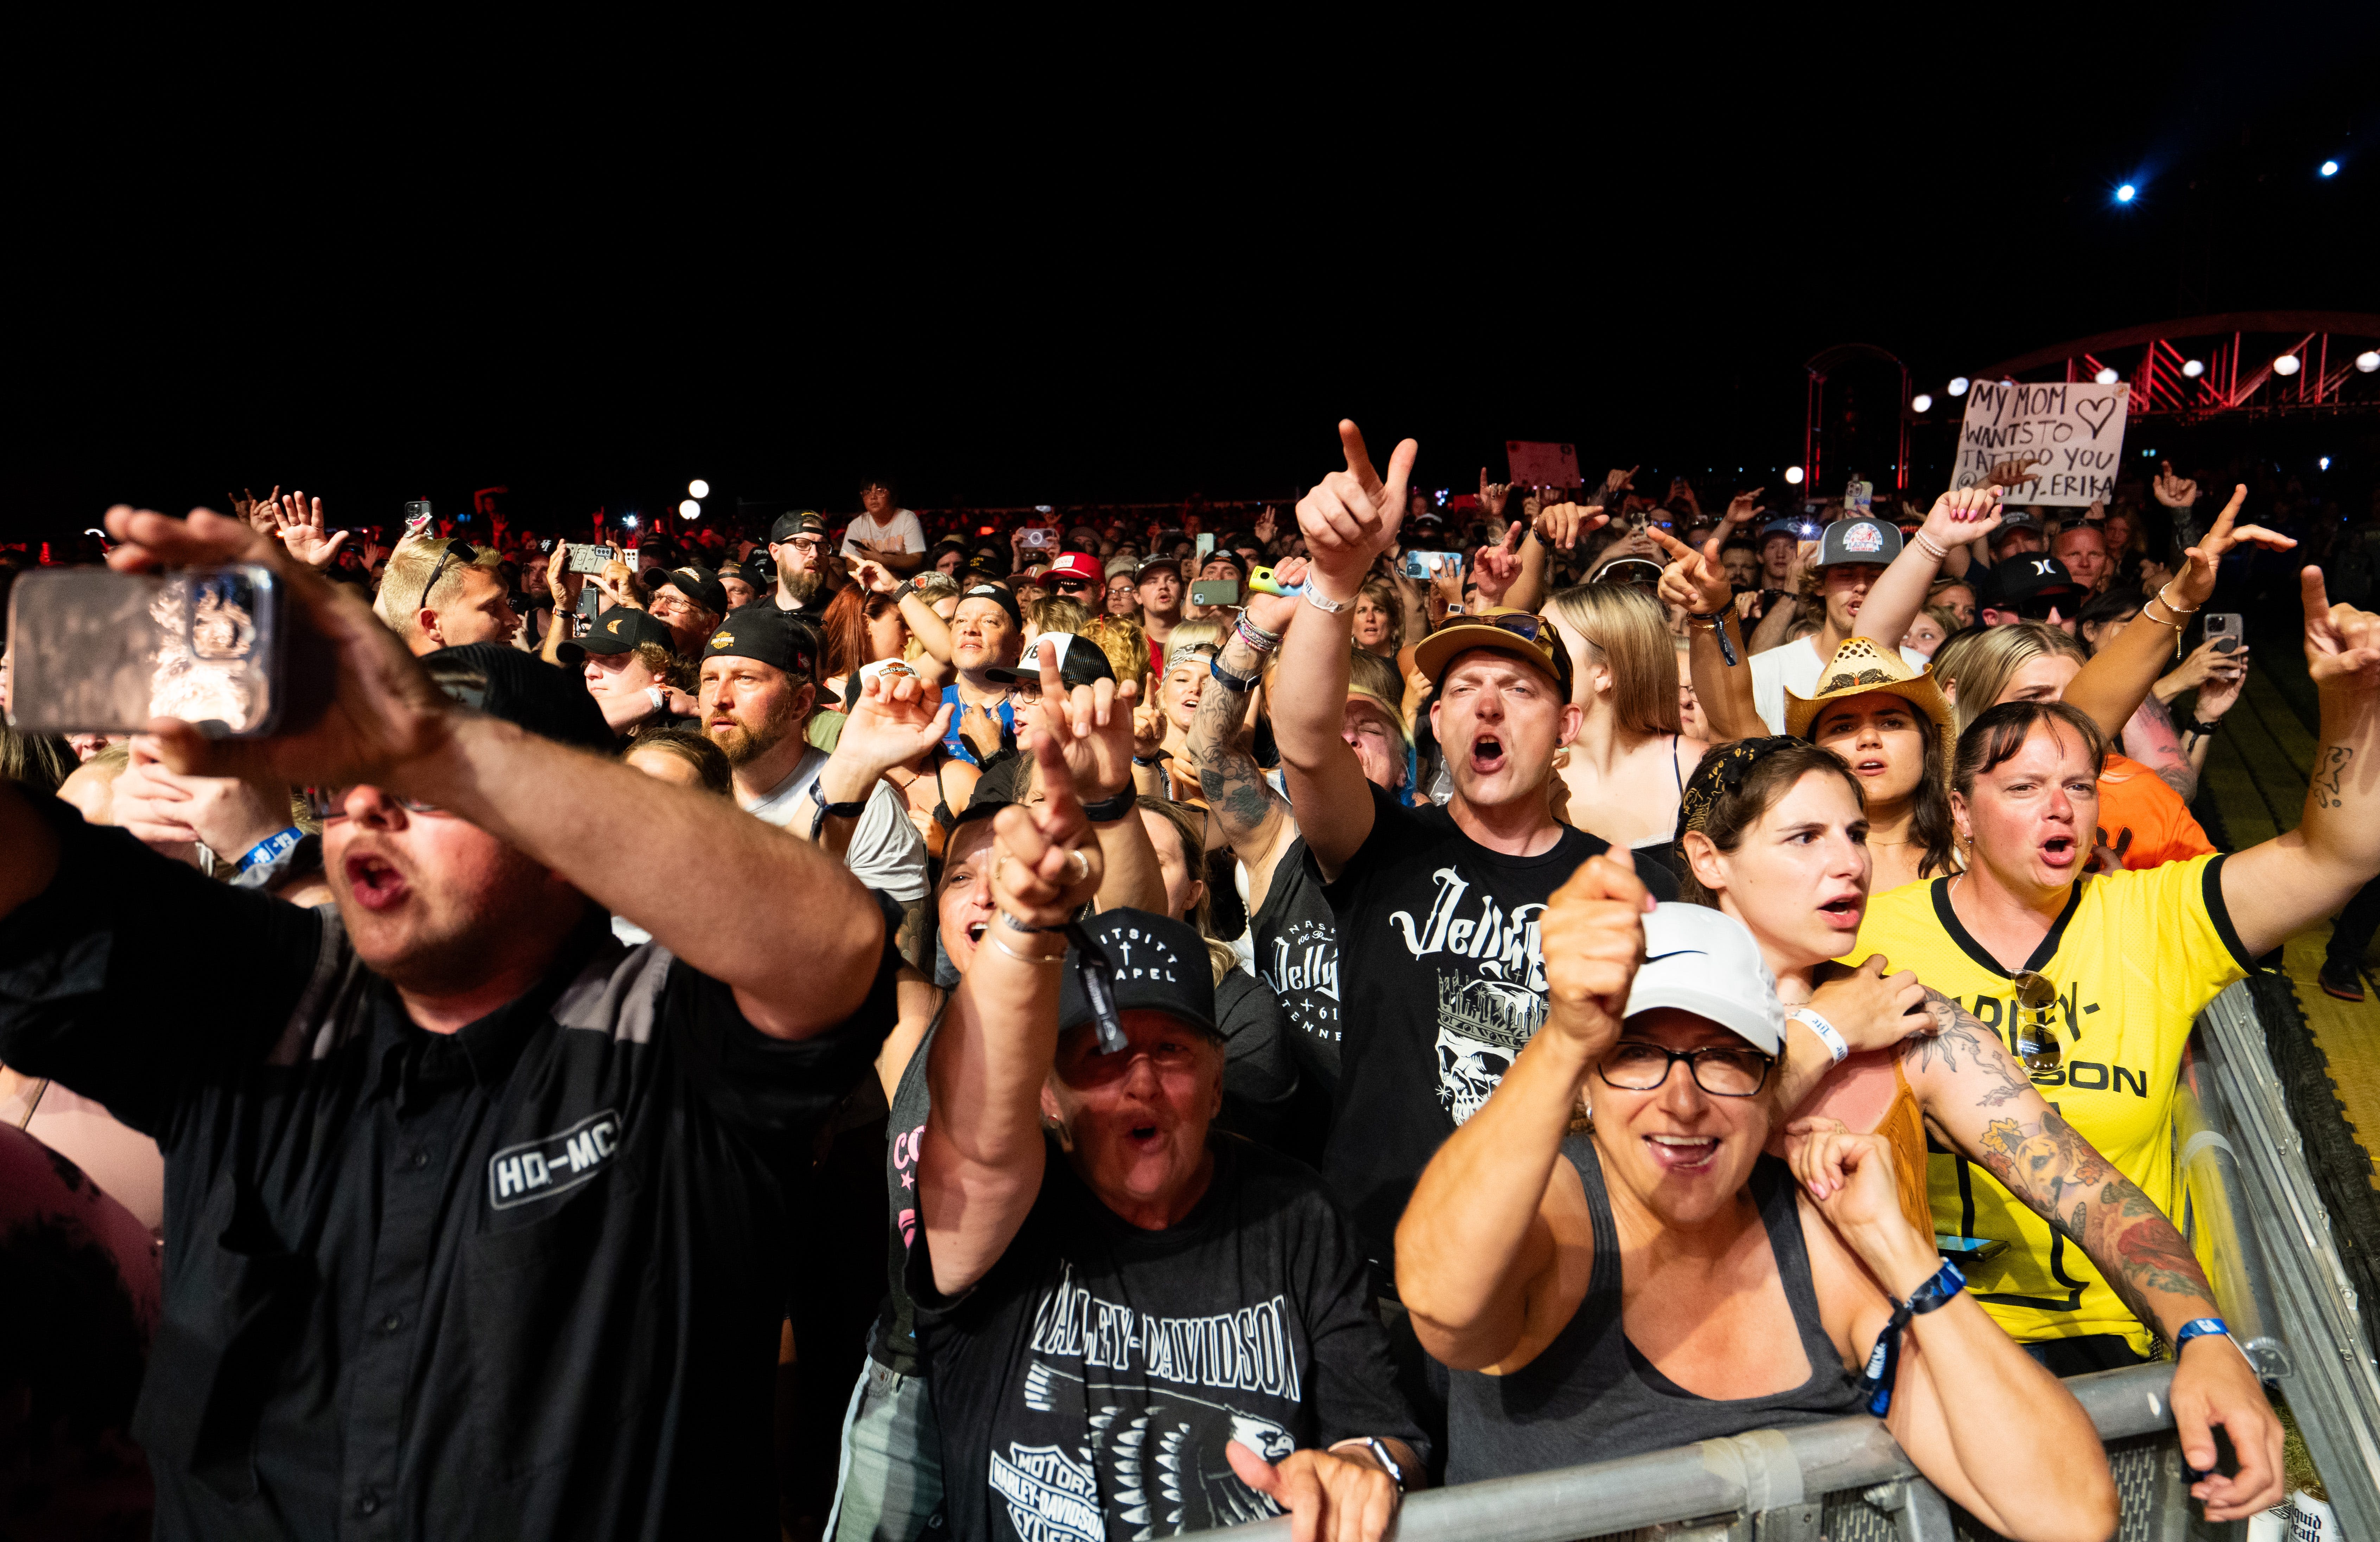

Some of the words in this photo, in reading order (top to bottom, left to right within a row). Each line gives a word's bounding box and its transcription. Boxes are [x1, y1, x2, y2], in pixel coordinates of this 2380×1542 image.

[1970, 384, 2009, 426] MY
[2012, 386, 2068, 418] MOM
[2063, 448, 2115, 471] YOU
[1100, 928, 1178, 963] ITSITT
[1297, 934, 1309, 945] 100
[1115, 968, 1176, 983] APEL
[1261, 936, 1340, 1001] Jelly
[1811, 1018, 1831, 1037] Lite
[2196, 1320, 2221, 1332] GA
[1017, 1453, 1086, 1496] MOTOR
[994, 1461, 1105, 1542] HARLEY-DAVIDSON
[2293, 1508, 2322, 1529] quid
[2292, 1521, 2321, 1542] eath
